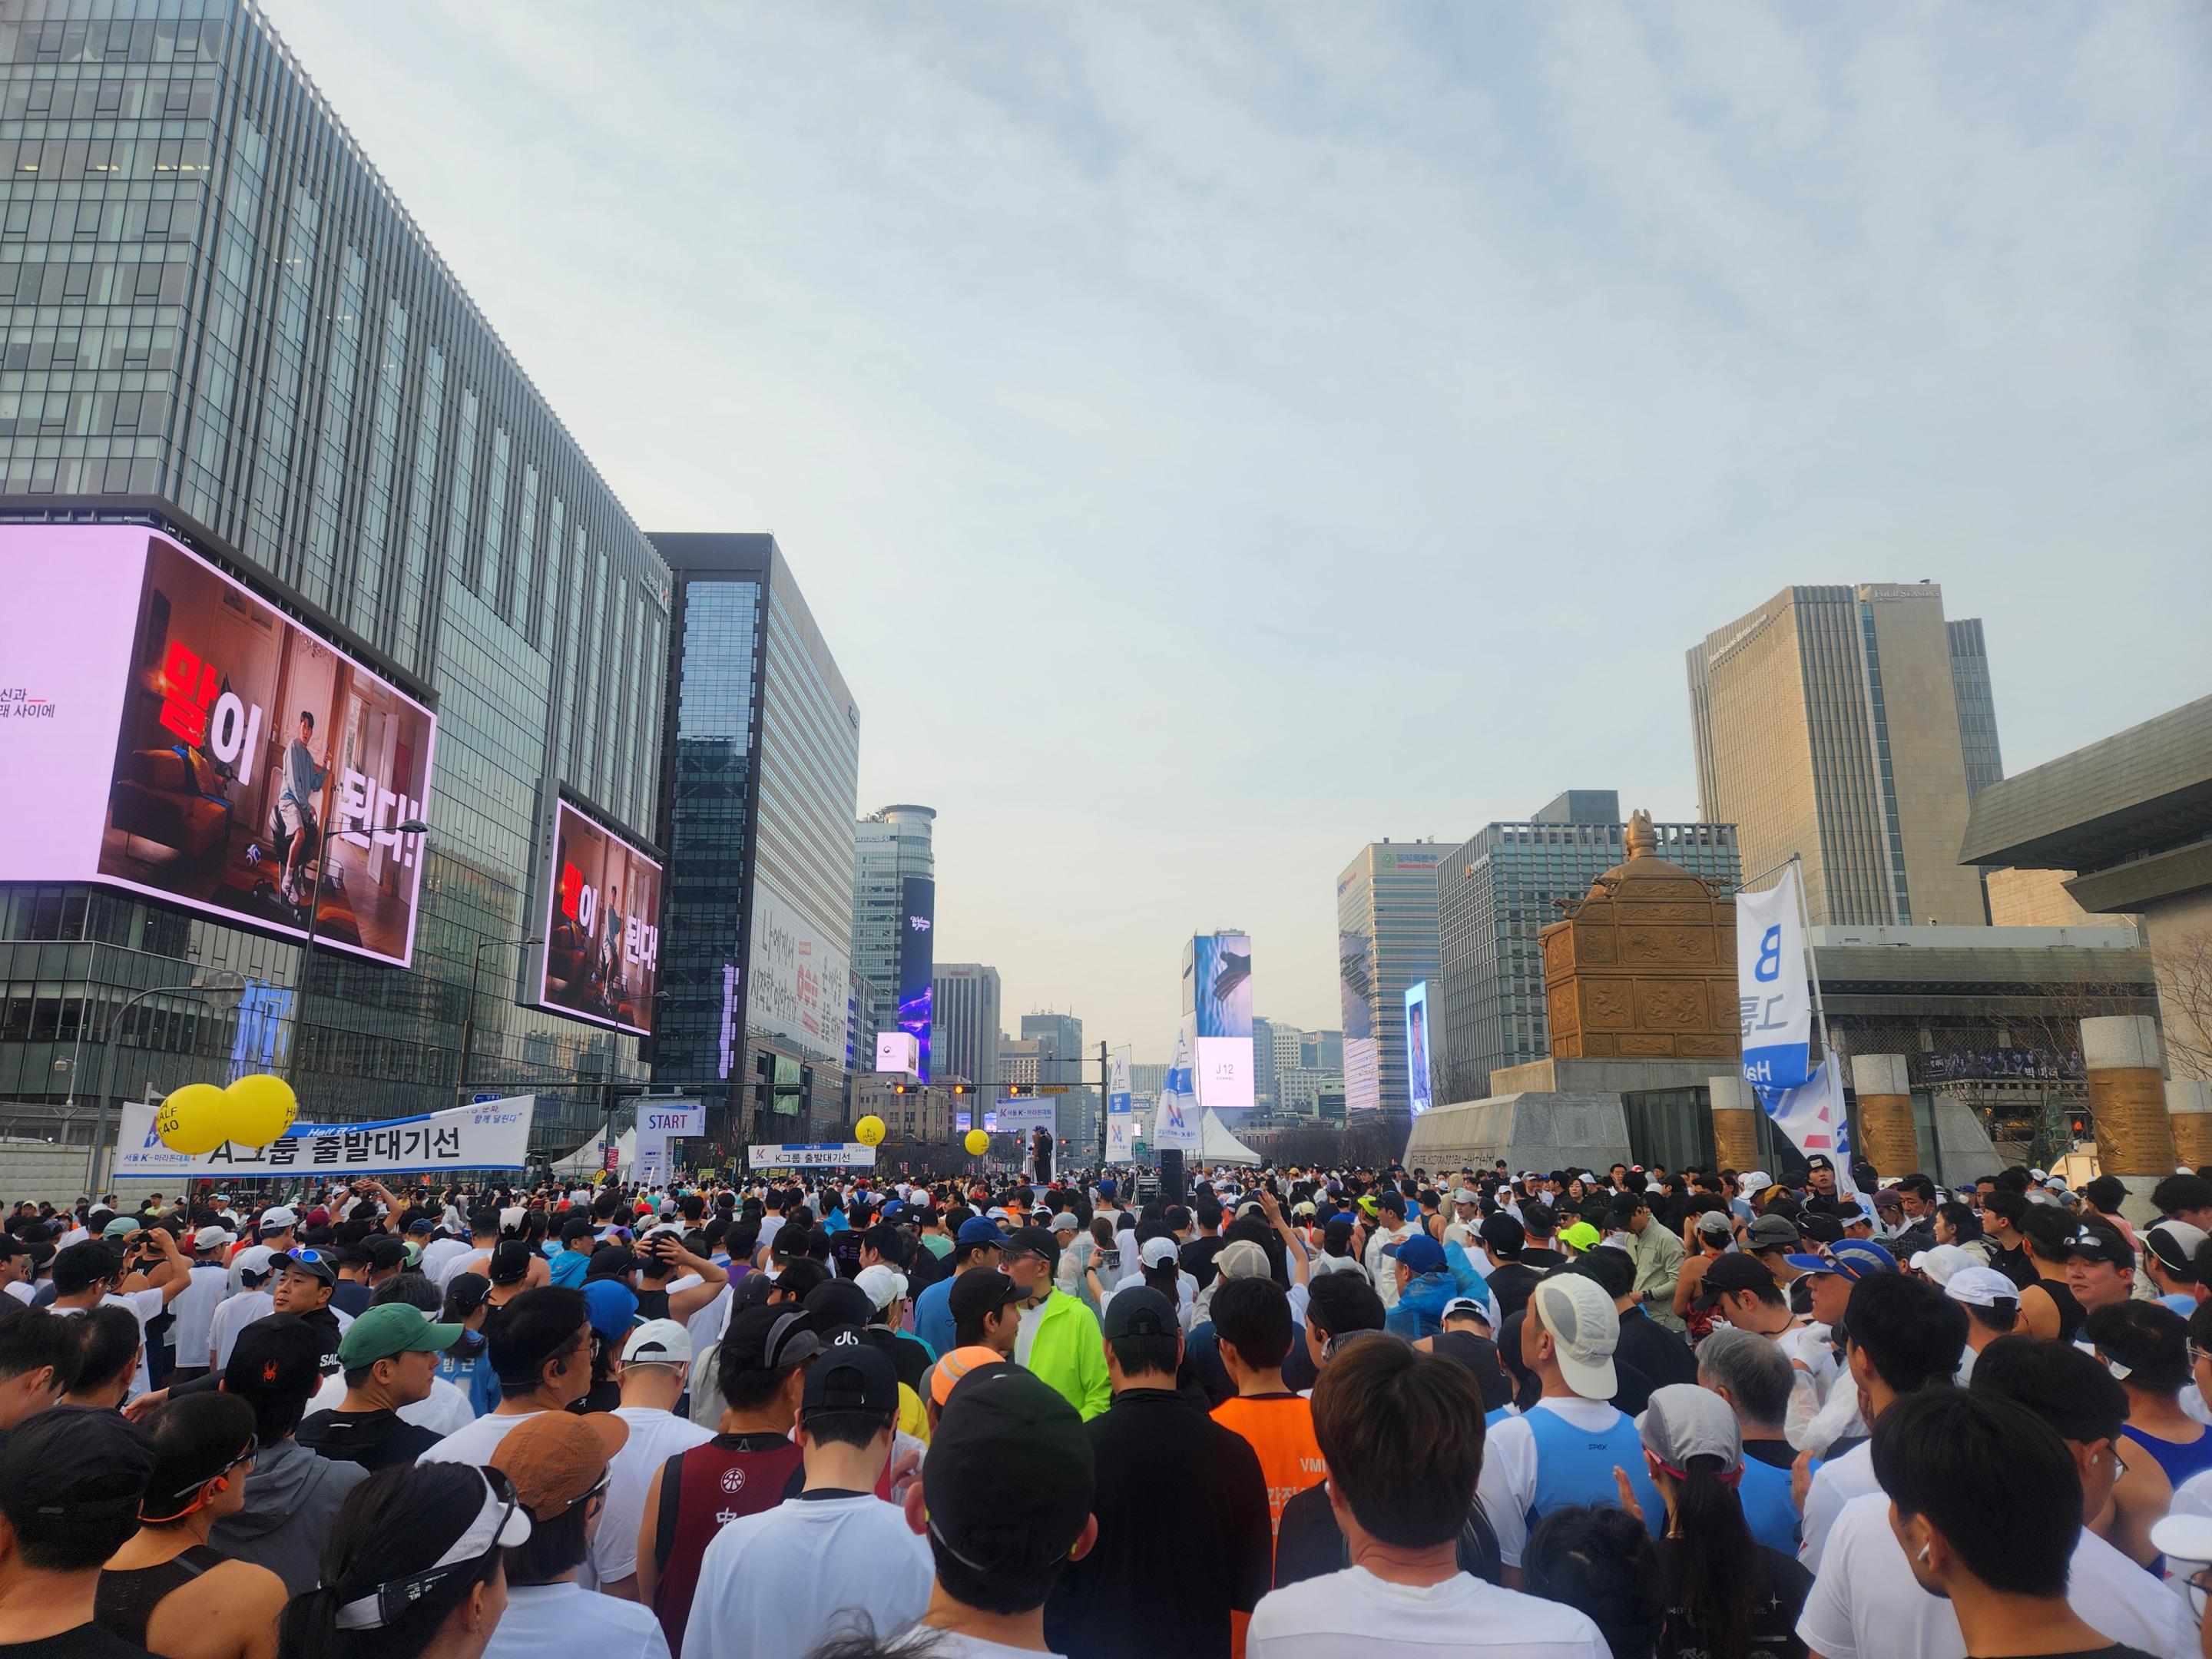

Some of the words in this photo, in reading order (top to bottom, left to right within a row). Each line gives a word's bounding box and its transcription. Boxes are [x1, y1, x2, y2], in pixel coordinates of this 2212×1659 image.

[13, 704, 55, 718] 사이에
[648, 1114, 687, 1130] START
[124, 1153, 139, 1162] 서울
[775, 1154, 800, 1164] K그룹
[805, 1153, 850, 1164] 출발대기선
